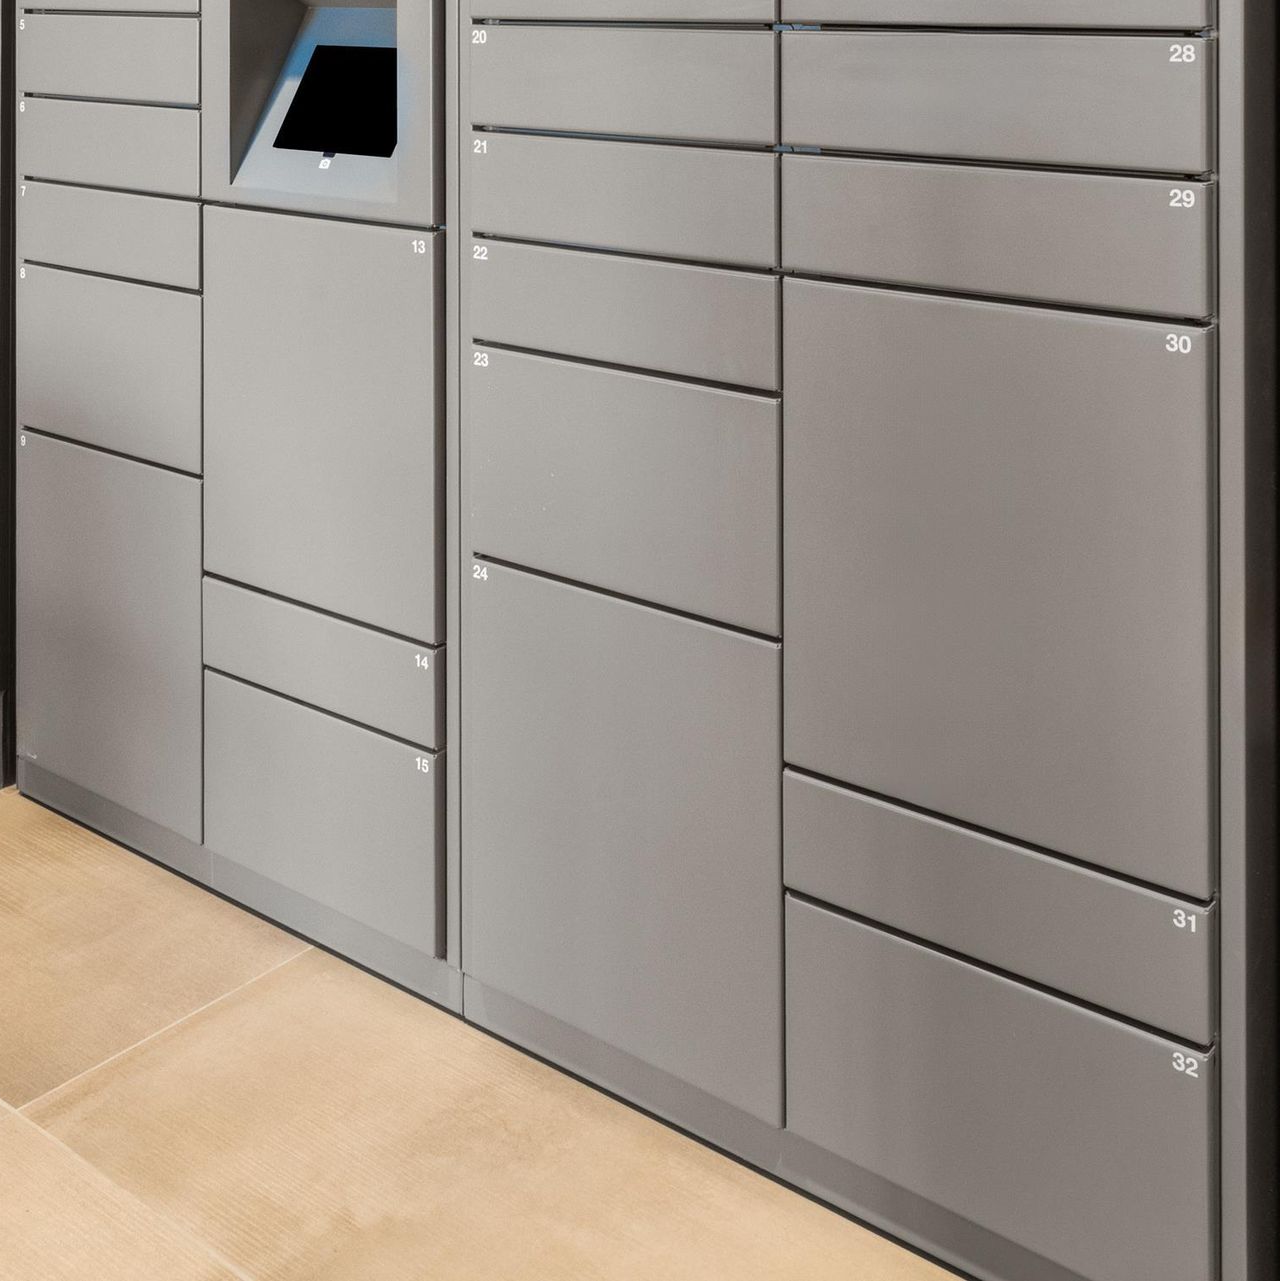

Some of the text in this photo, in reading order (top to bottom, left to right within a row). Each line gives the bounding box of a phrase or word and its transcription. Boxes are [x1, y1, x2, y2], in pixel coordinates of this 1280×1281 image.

[19, 18, 25, 30] 5
[471, 29, 487, 44] 20
[1169, 44, 1196, 63] 28
[19, 101, 26, 113] 6
[473, 138, 487, 154] 21
[20, 185, 27, 197] 7
[1169, 188, 1195, 208] 29
[411, 239, 426, 254] 13
[473, 245, 489, 261] 22
[19, 267, 26, 279] 8
[1165, 333, 1192, 354] 30
[473, 351, 489, 367] 23
[20, 435, 26, 447] 9
[472, 564, 489, 581] 24
[414, 653, 429, 670] 14
[415, 756, 429, 773] 15
[1172, 908, 1197, 933] 31
[1172, 1052, 1199, 1078] 32
